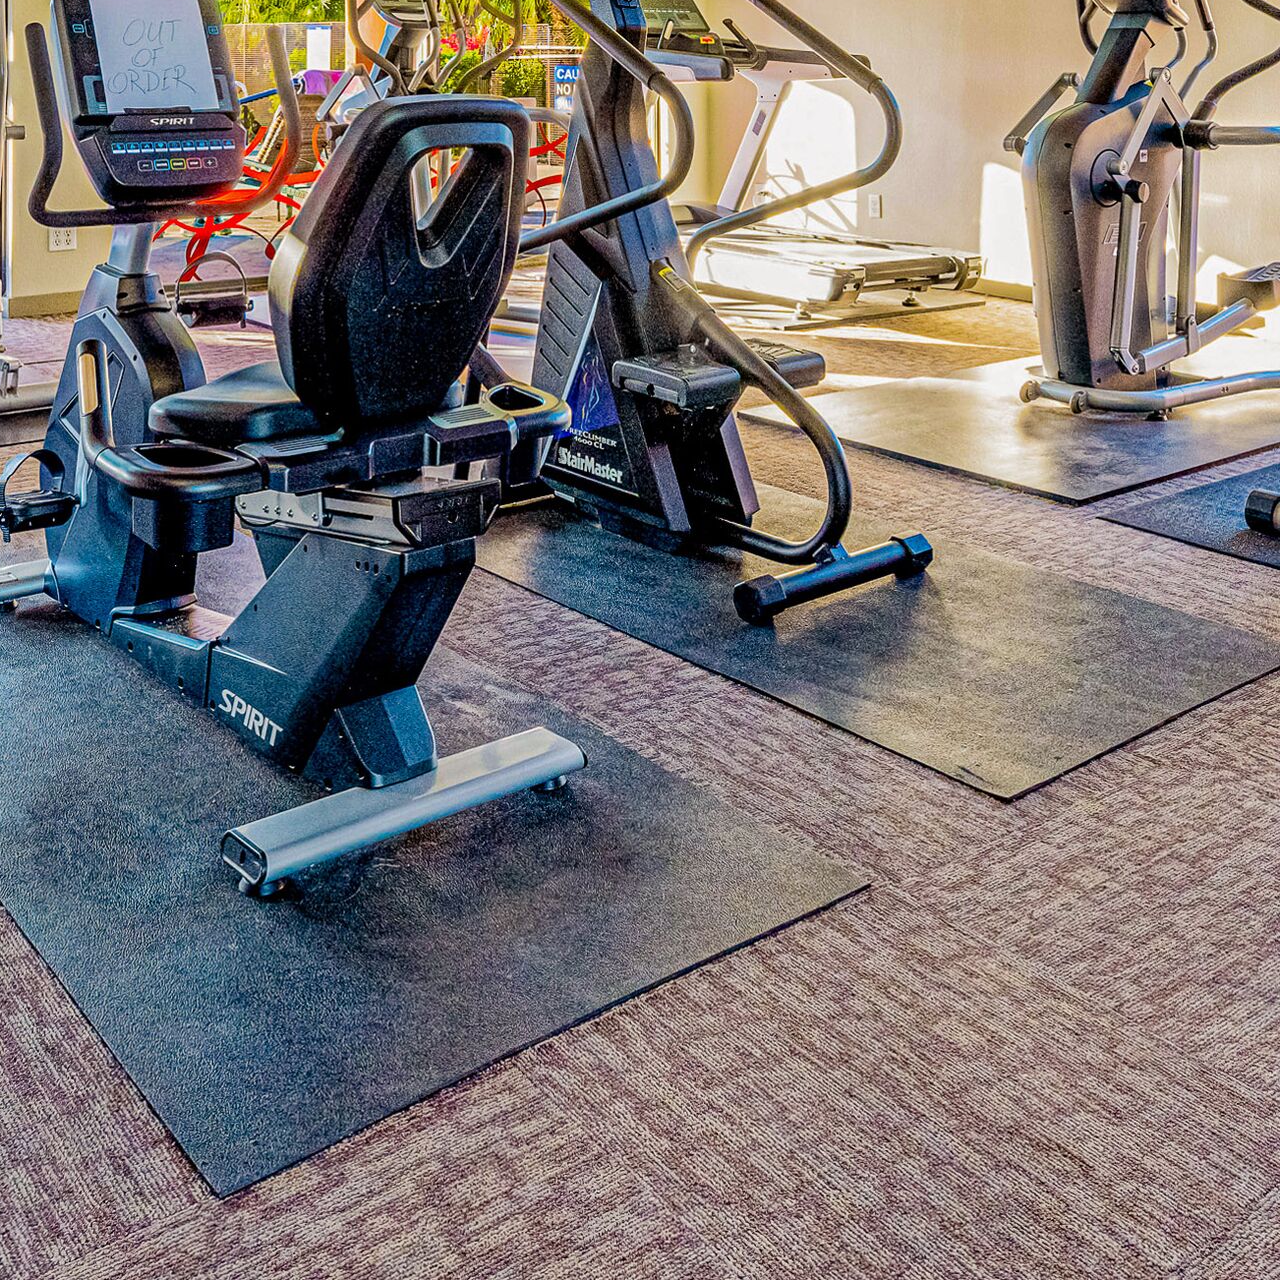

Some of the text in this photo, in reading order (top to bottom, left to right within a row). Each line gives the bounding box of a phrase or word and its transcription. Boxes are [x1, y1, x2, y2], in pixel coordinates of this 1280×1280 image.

[123, 19, 181, 46] OUT
[131, 47, 164, 67] OF
[108, 65, 198, 95] ORDER
[556, 83, 571, 95] NO
[150, 117, 195, 125] SPIRIT
[558, 447, 623, 483] StairMaster
[218, 689, 284, 747] SPIRIT
